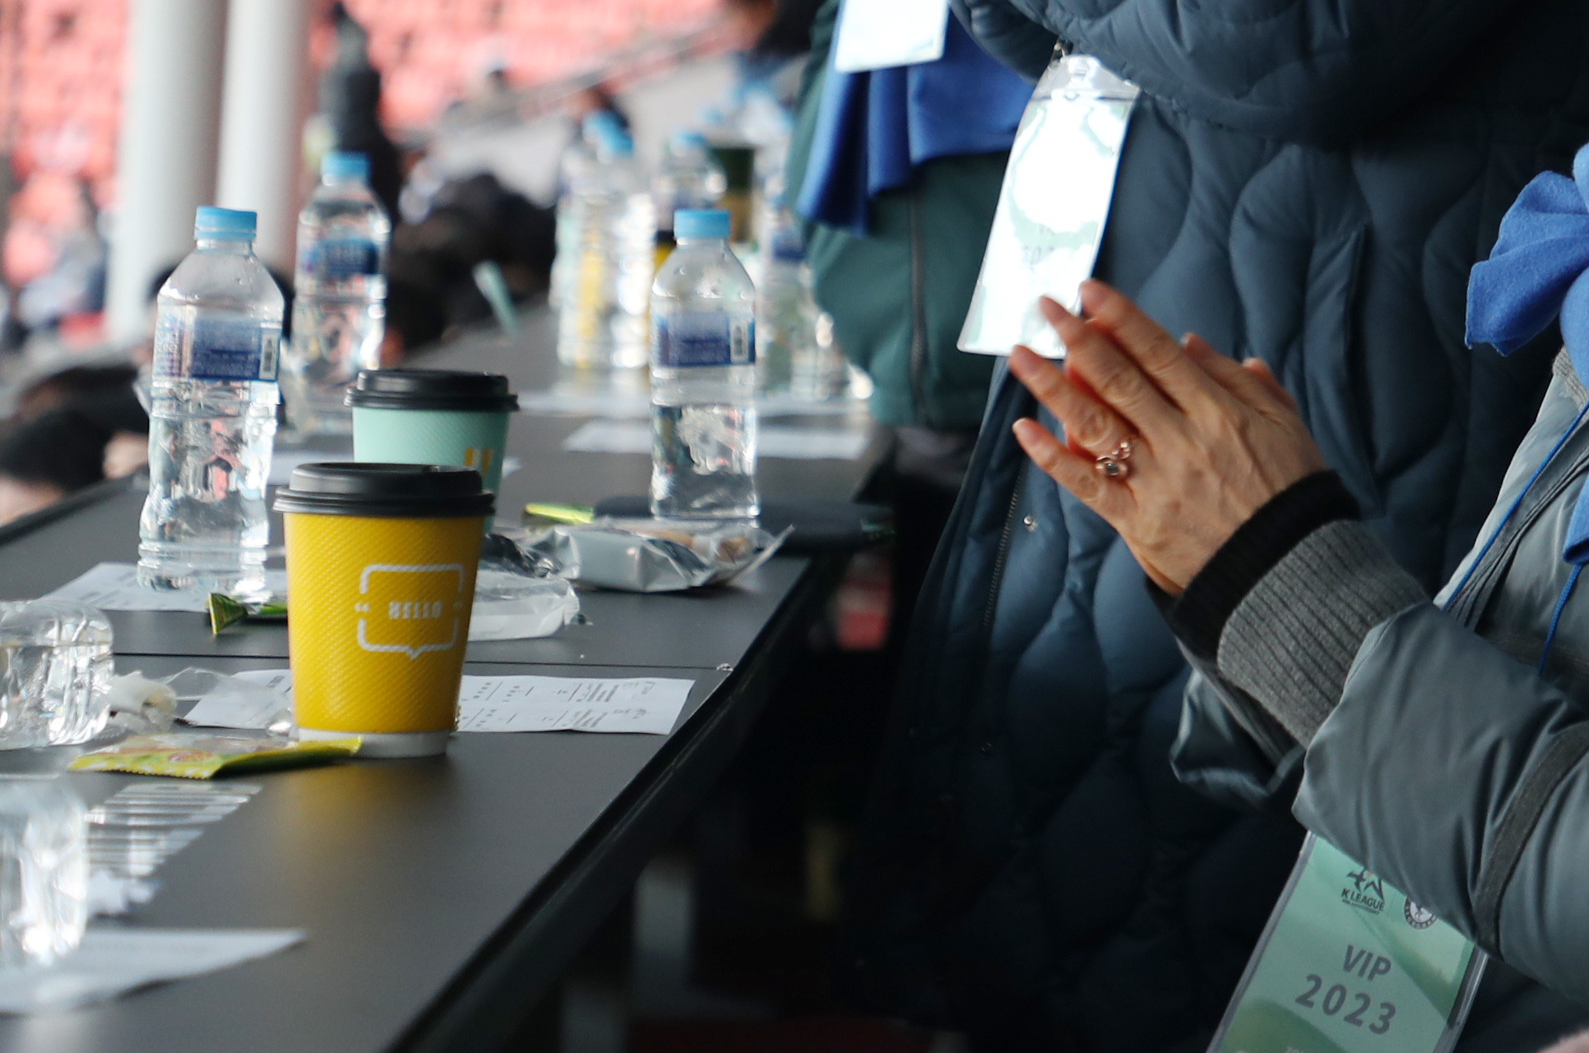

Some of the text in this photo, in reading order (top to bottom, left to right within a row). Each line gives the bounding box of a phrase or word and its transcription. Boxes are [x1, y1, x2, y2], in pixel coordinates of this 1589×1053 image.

[388, 600, 443, 619] HELLO
[1341, 888, 1350, 898] K
[1350, 891, 1385, 911] LEAGUE
[1342, 944, 1392, 982] VIP
[1295, 973, 1397, 1035] 2023
